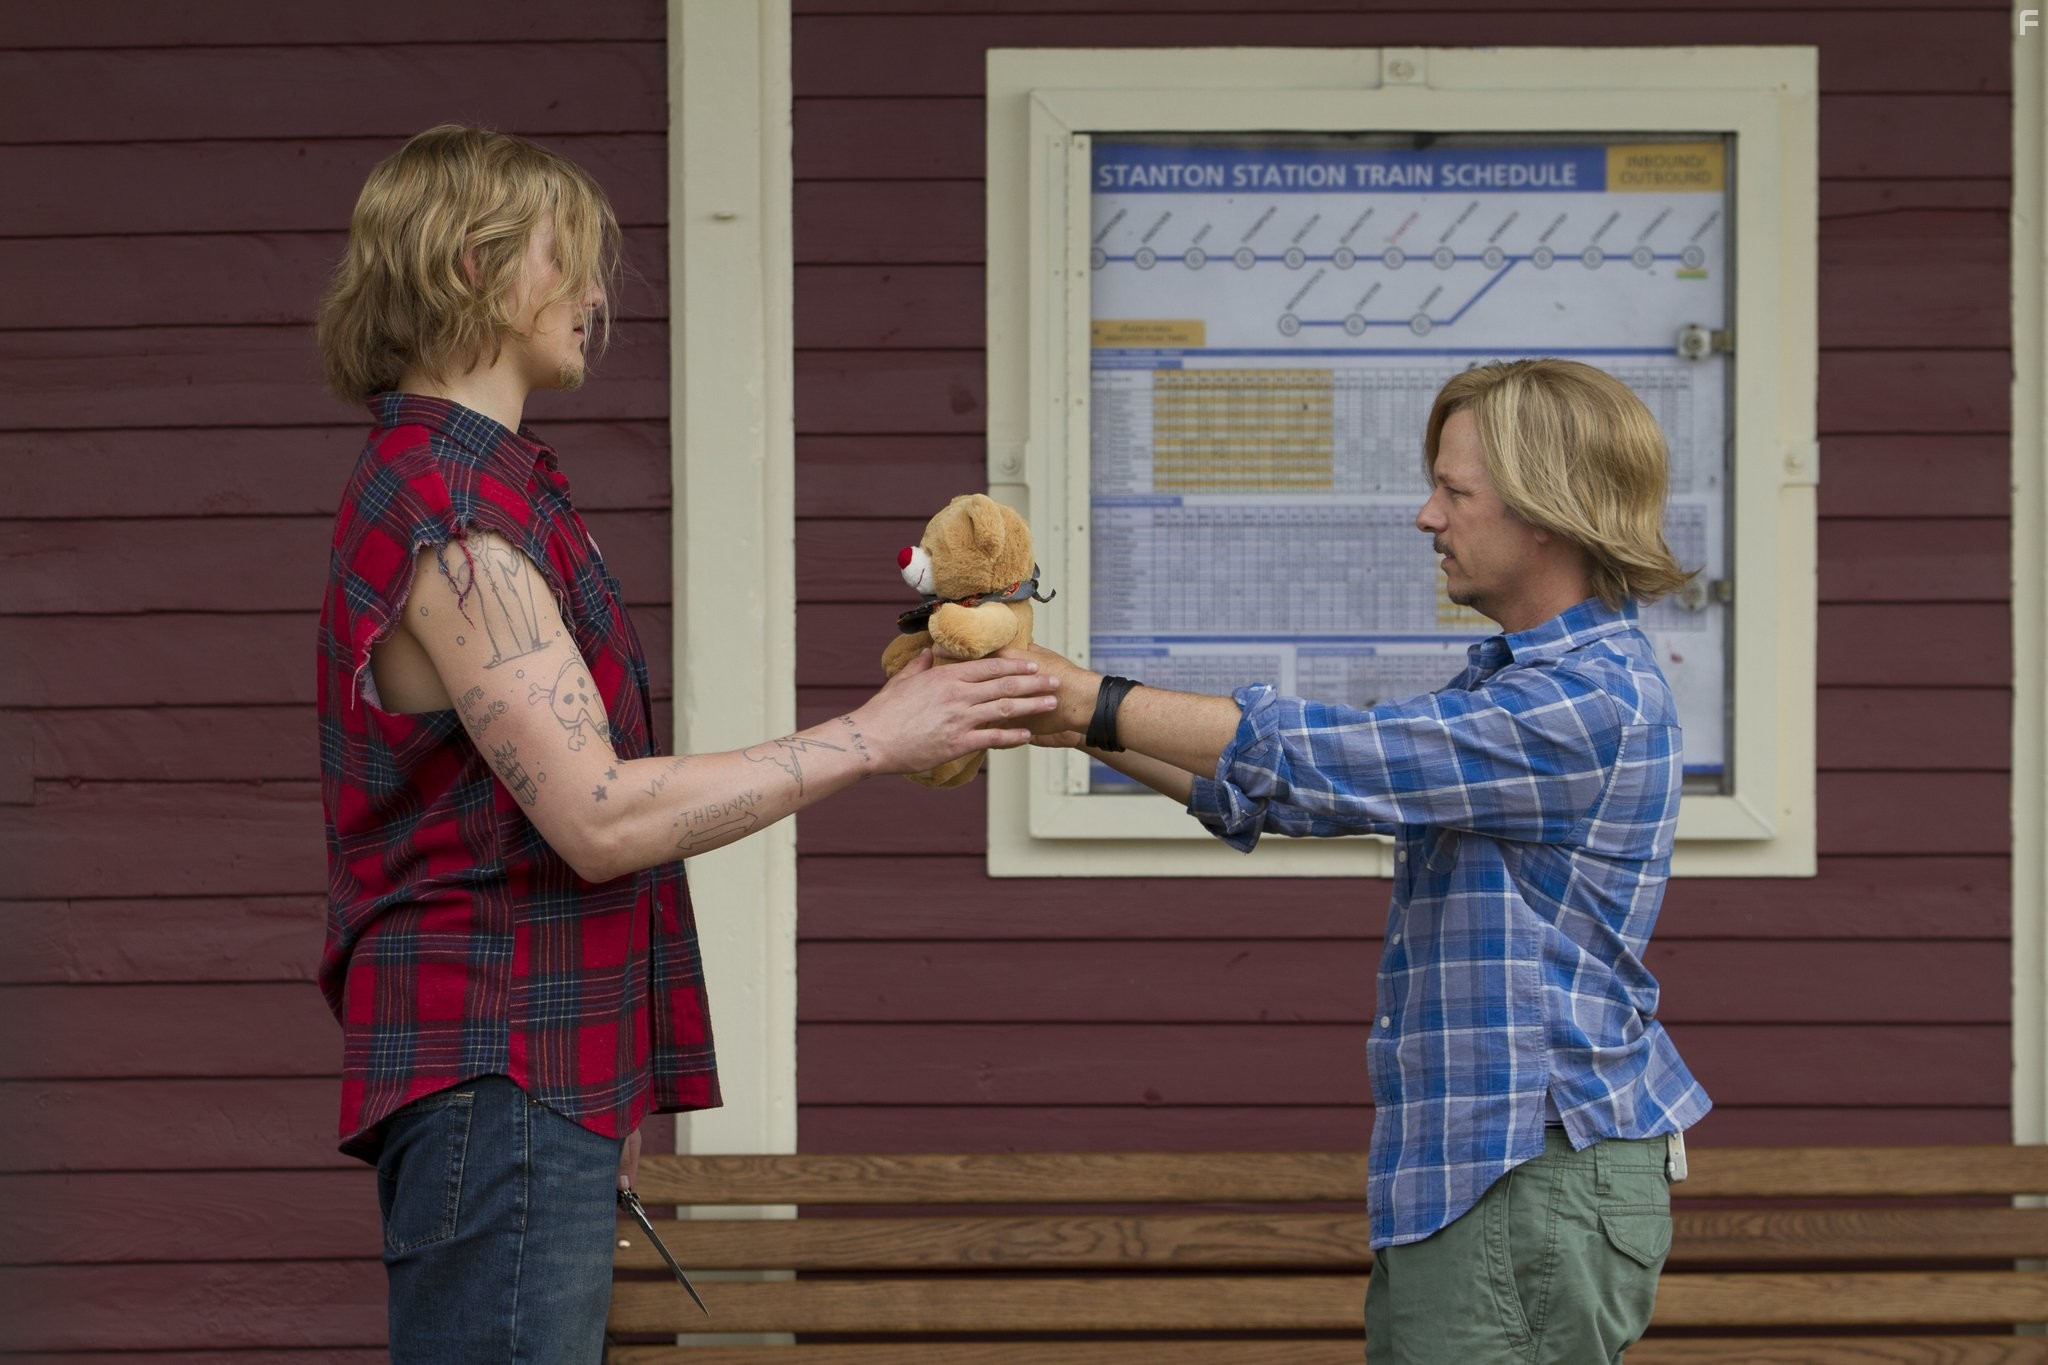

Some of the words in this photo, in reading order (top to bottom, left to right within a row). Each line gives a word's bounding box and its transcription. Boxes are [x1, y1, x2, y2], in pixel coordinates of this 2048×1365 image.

[1625, 154, 1706, 169] INBOUND/
[1098, 164, 1224, 187] STANTON
[1232, 164, 1346, 187] STATION
[1353, 163, 1434, 187] TRAIN
[1441, 163, 1577, 187] SCHEDULE
[1619, 170, 1712, 185] OUTBOUND
[456, 685, 486, 715] LIFE
[680, 804, 721, 827] THIS
